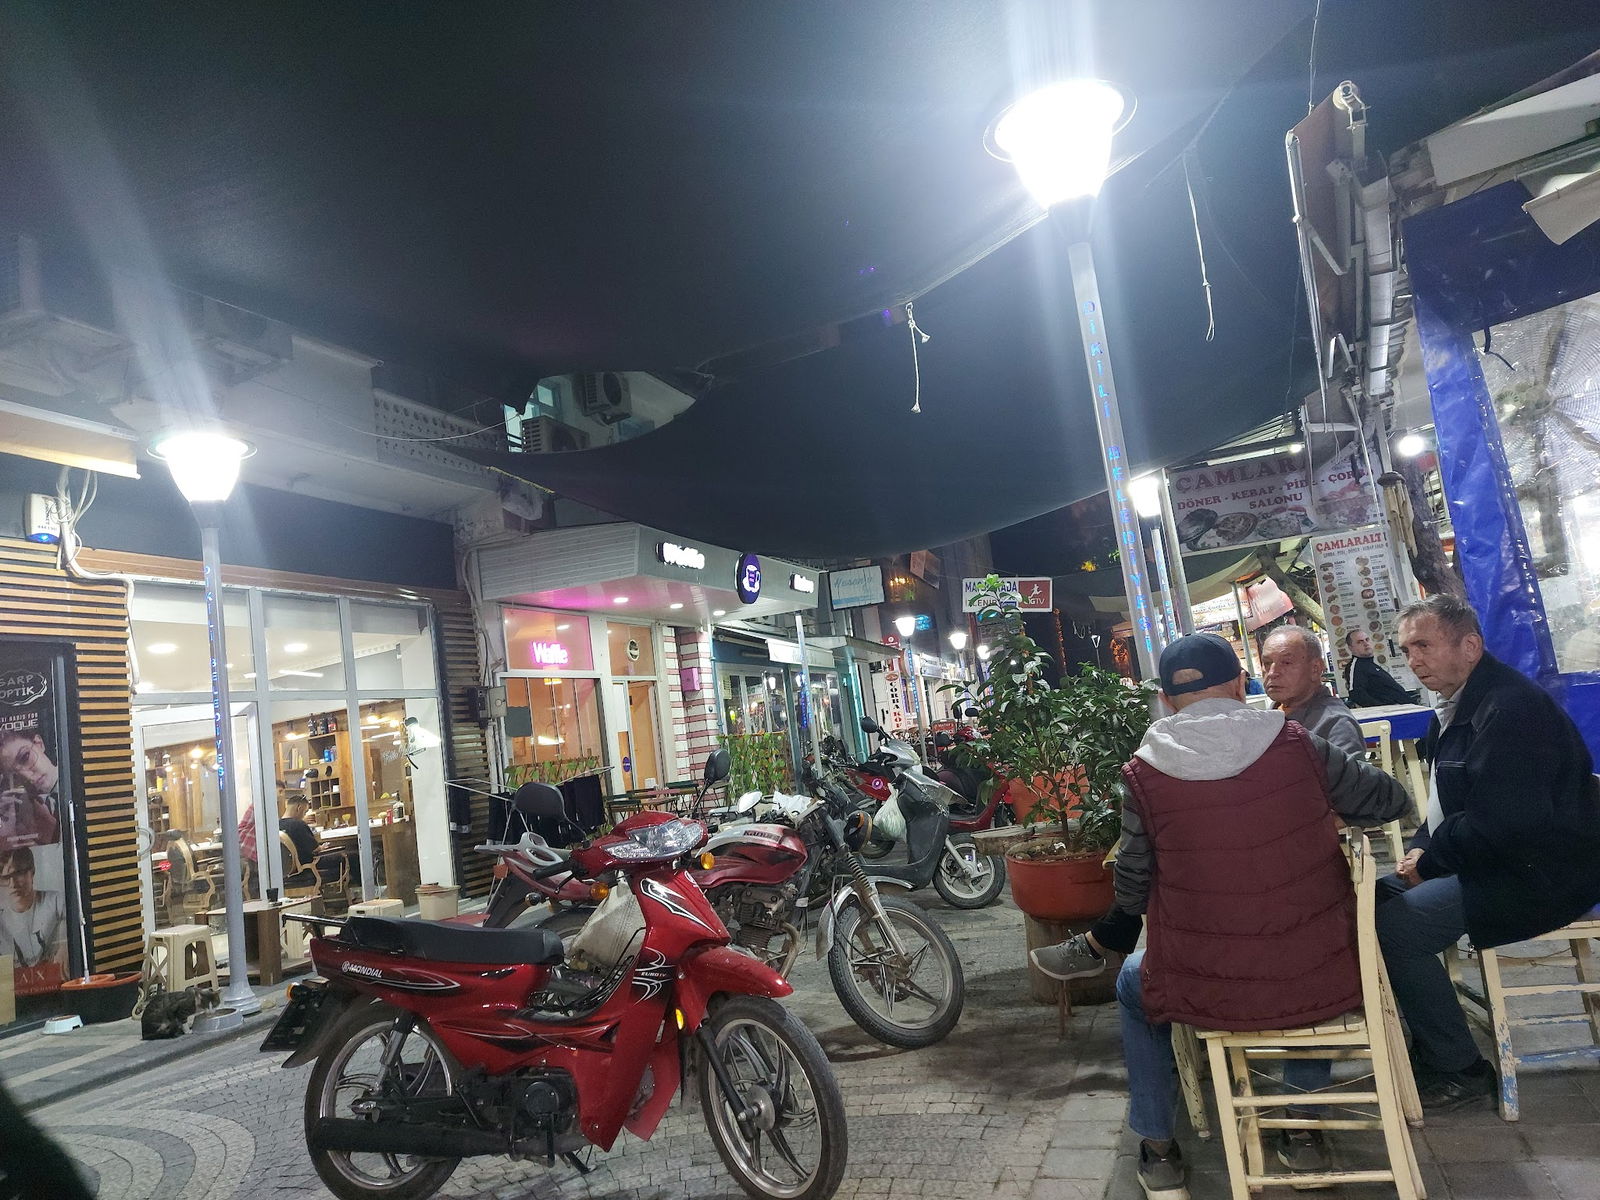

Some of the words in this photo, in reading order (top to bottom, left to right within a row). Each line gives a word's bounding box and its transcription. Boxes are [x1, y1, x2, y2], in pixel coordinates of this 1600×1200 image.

[1177, 494, 1222, 510] DÖNER
[1231, 485, 1274, 505] KEBAP
[1249, 492, 1303, 509] SALONU
[0, 684, 35, 699] OPTİK
[348, 963, 385, 978] MONDIAL
